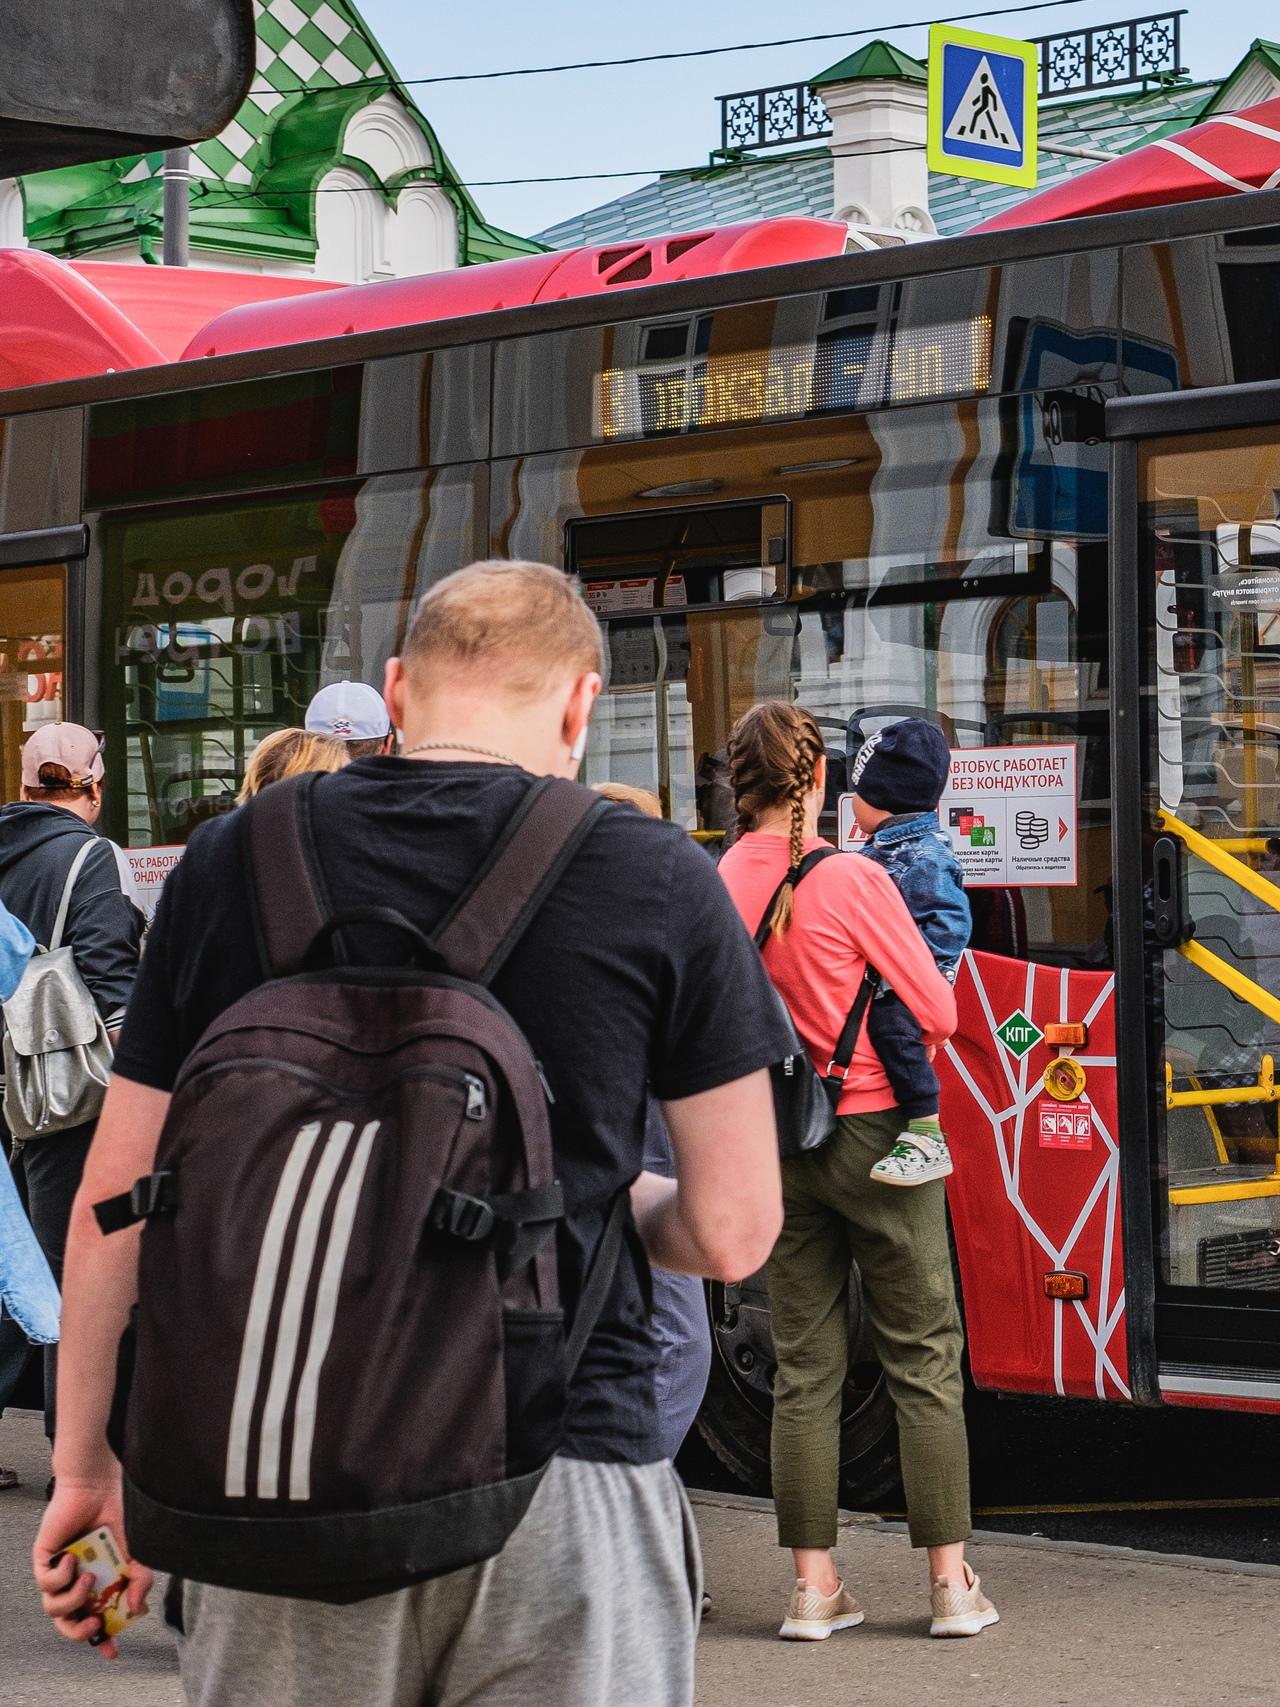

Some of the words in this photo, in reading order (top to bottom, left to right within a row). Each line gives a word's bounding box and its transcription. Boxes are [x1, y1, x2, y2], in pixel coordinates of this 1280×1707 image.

[948, 760, 1001, 774] ВТОБУС
[1003, 757, 1068, 772] РАБОТАЕТ
[952, 777, 974, 790] БЕЗ
[977, 775, 1064, 792] КОНДУКТОРА
[1043, 856, 1071, 864] средства
[1006, 1026, 1033, 1042] КПГ
